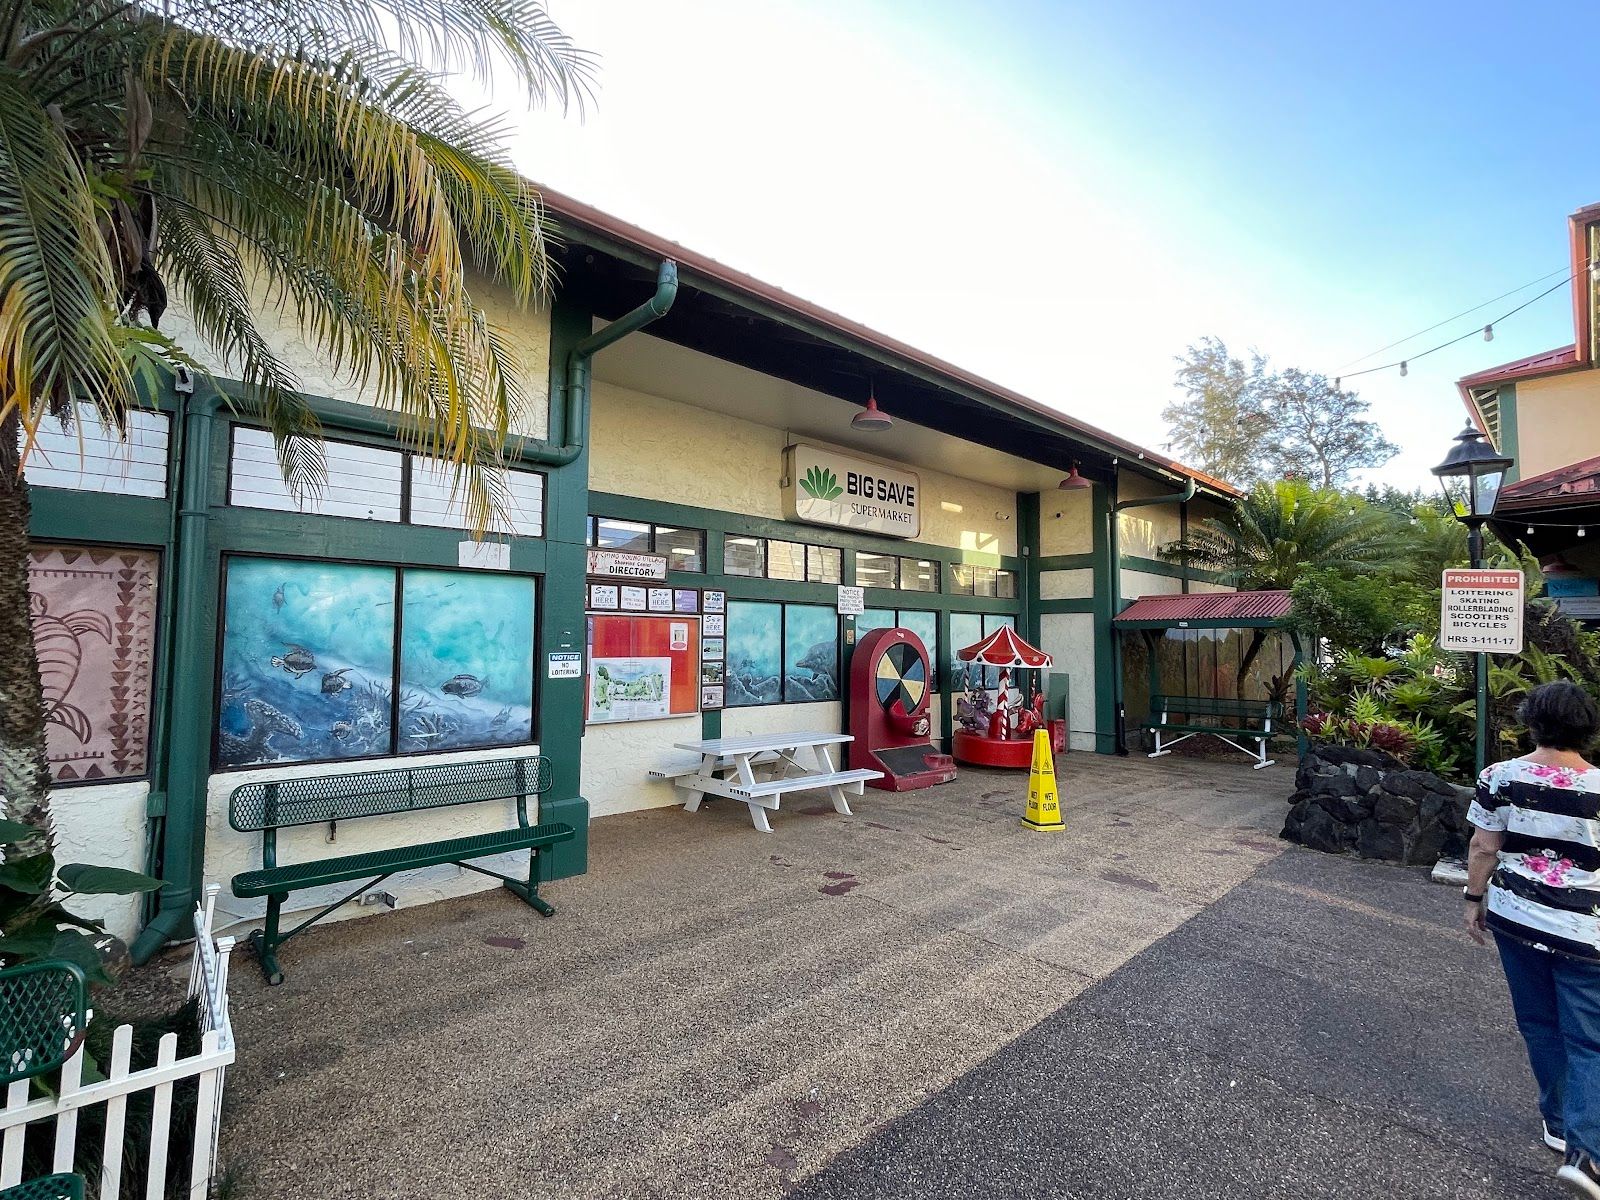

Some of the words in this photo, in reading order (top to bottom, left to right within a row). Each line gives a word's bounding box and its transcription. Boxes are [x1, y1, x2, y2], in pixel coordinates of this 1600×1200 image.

[847, 472, 874, 498] BIG
[877, 479, 914, 507] SAVE
[851, 503, 912, 524] SUPERMARKET
[609, 565, 656, 577] DIRECTORY
[1447, 575, 1518, 584] PROHIBITED
[1447, 605, 1514, 613] ROLLERBLADING
[1453, 621, 1507, 629] BICYCLES
[1447, 635, 1468, 643] HRS
[1471, 637, 1515, 645] 3-111-17
[1043, 803, 1057, 811] FLOOR
